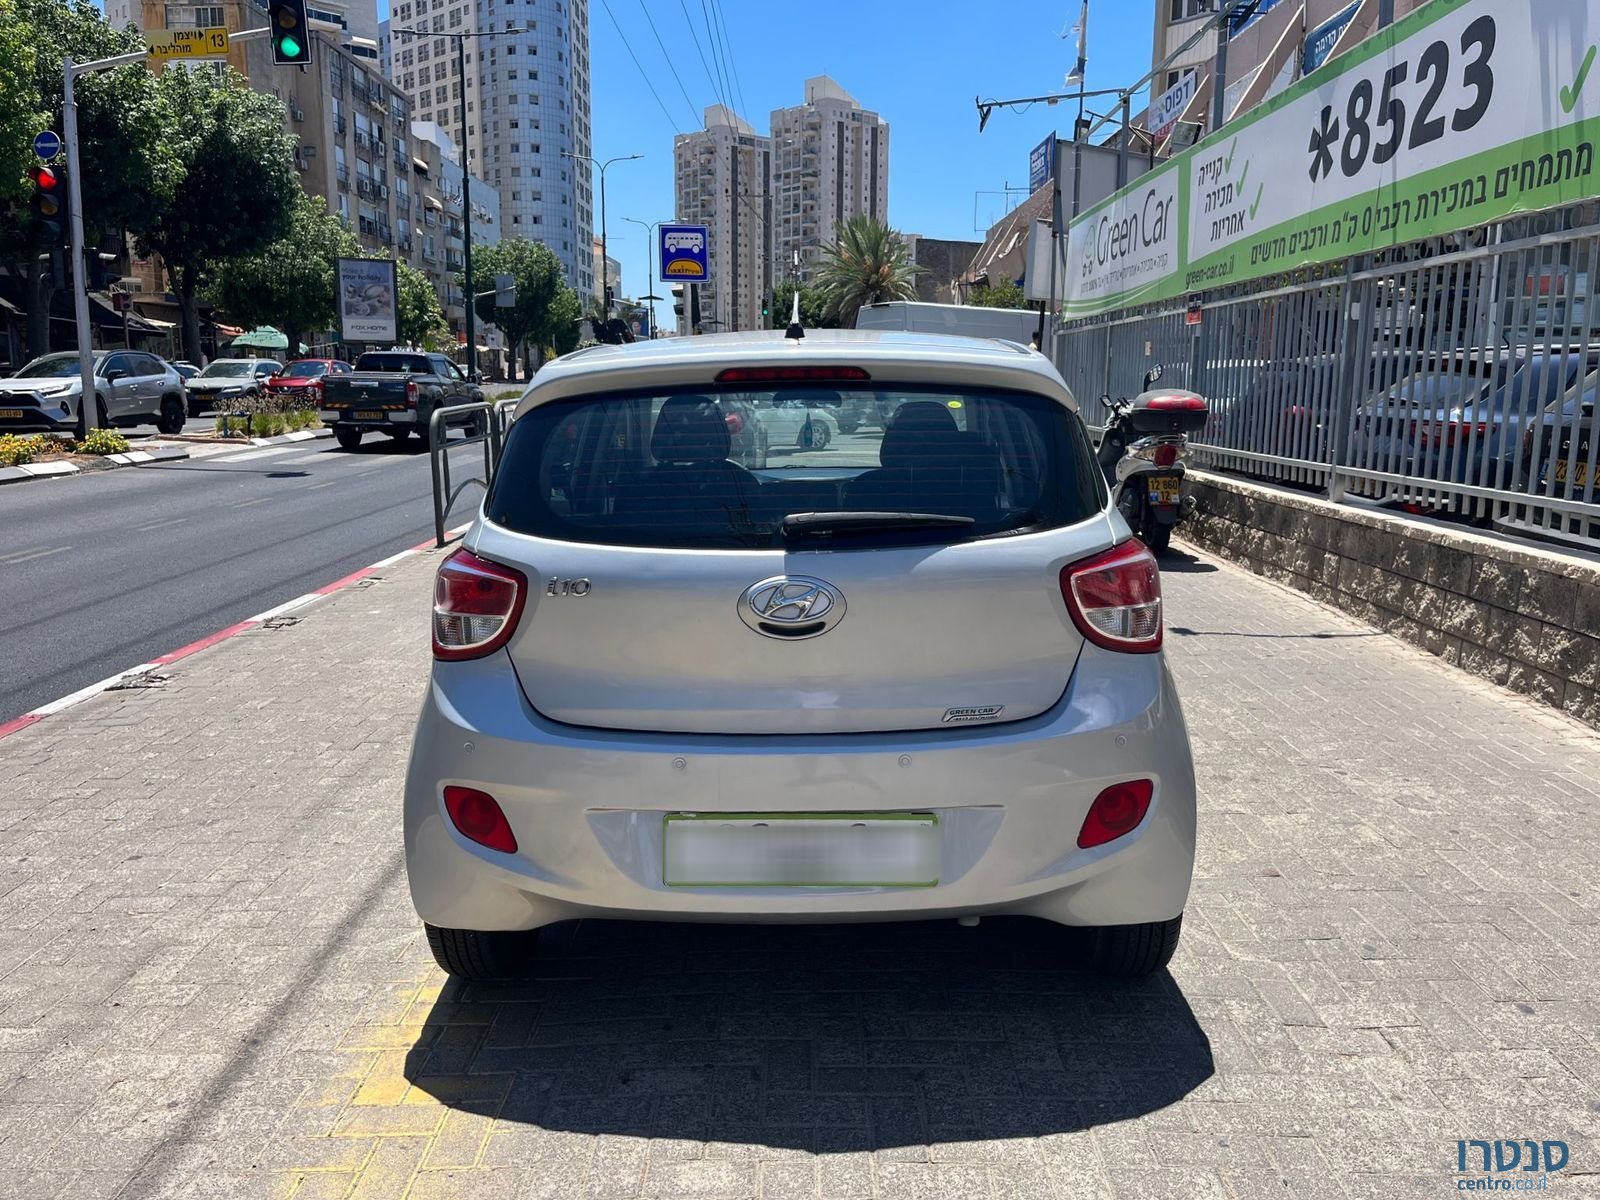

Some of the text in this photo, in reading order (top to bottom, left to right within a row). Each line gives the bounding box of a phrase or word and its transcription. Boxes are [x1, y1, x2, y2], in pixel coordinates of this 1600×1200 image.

[156, 42, 192, 54] מוהליבר
[173, 31, 197, 43] ויצמן
[210, 34, 225, 48] 13
[1165, 80, 1190, 113] דפוס
[1198, 156, 1223, 186] קנייה
[1494, 142, 1593, 199] מתמחים
[1205, 182, 1233, 213] מכירה
[1414, 175, 1487, 222] במכירת
[1097, 188, 1173, 266] Green Car
[1210, 209, 1246, 242] אחריות
[1361, 206, 1372, 236] 0
[1376, 199, 1411, 232] רכבי
[1250, 237, 1287, 266] חדשים
[1289, 223, 1329, 256] ורכבים
[1185, 254, 1235, 290] green-car.co.il
[1150, 480, 1160, 490] 12
[546, 576, 591, 597] i10
